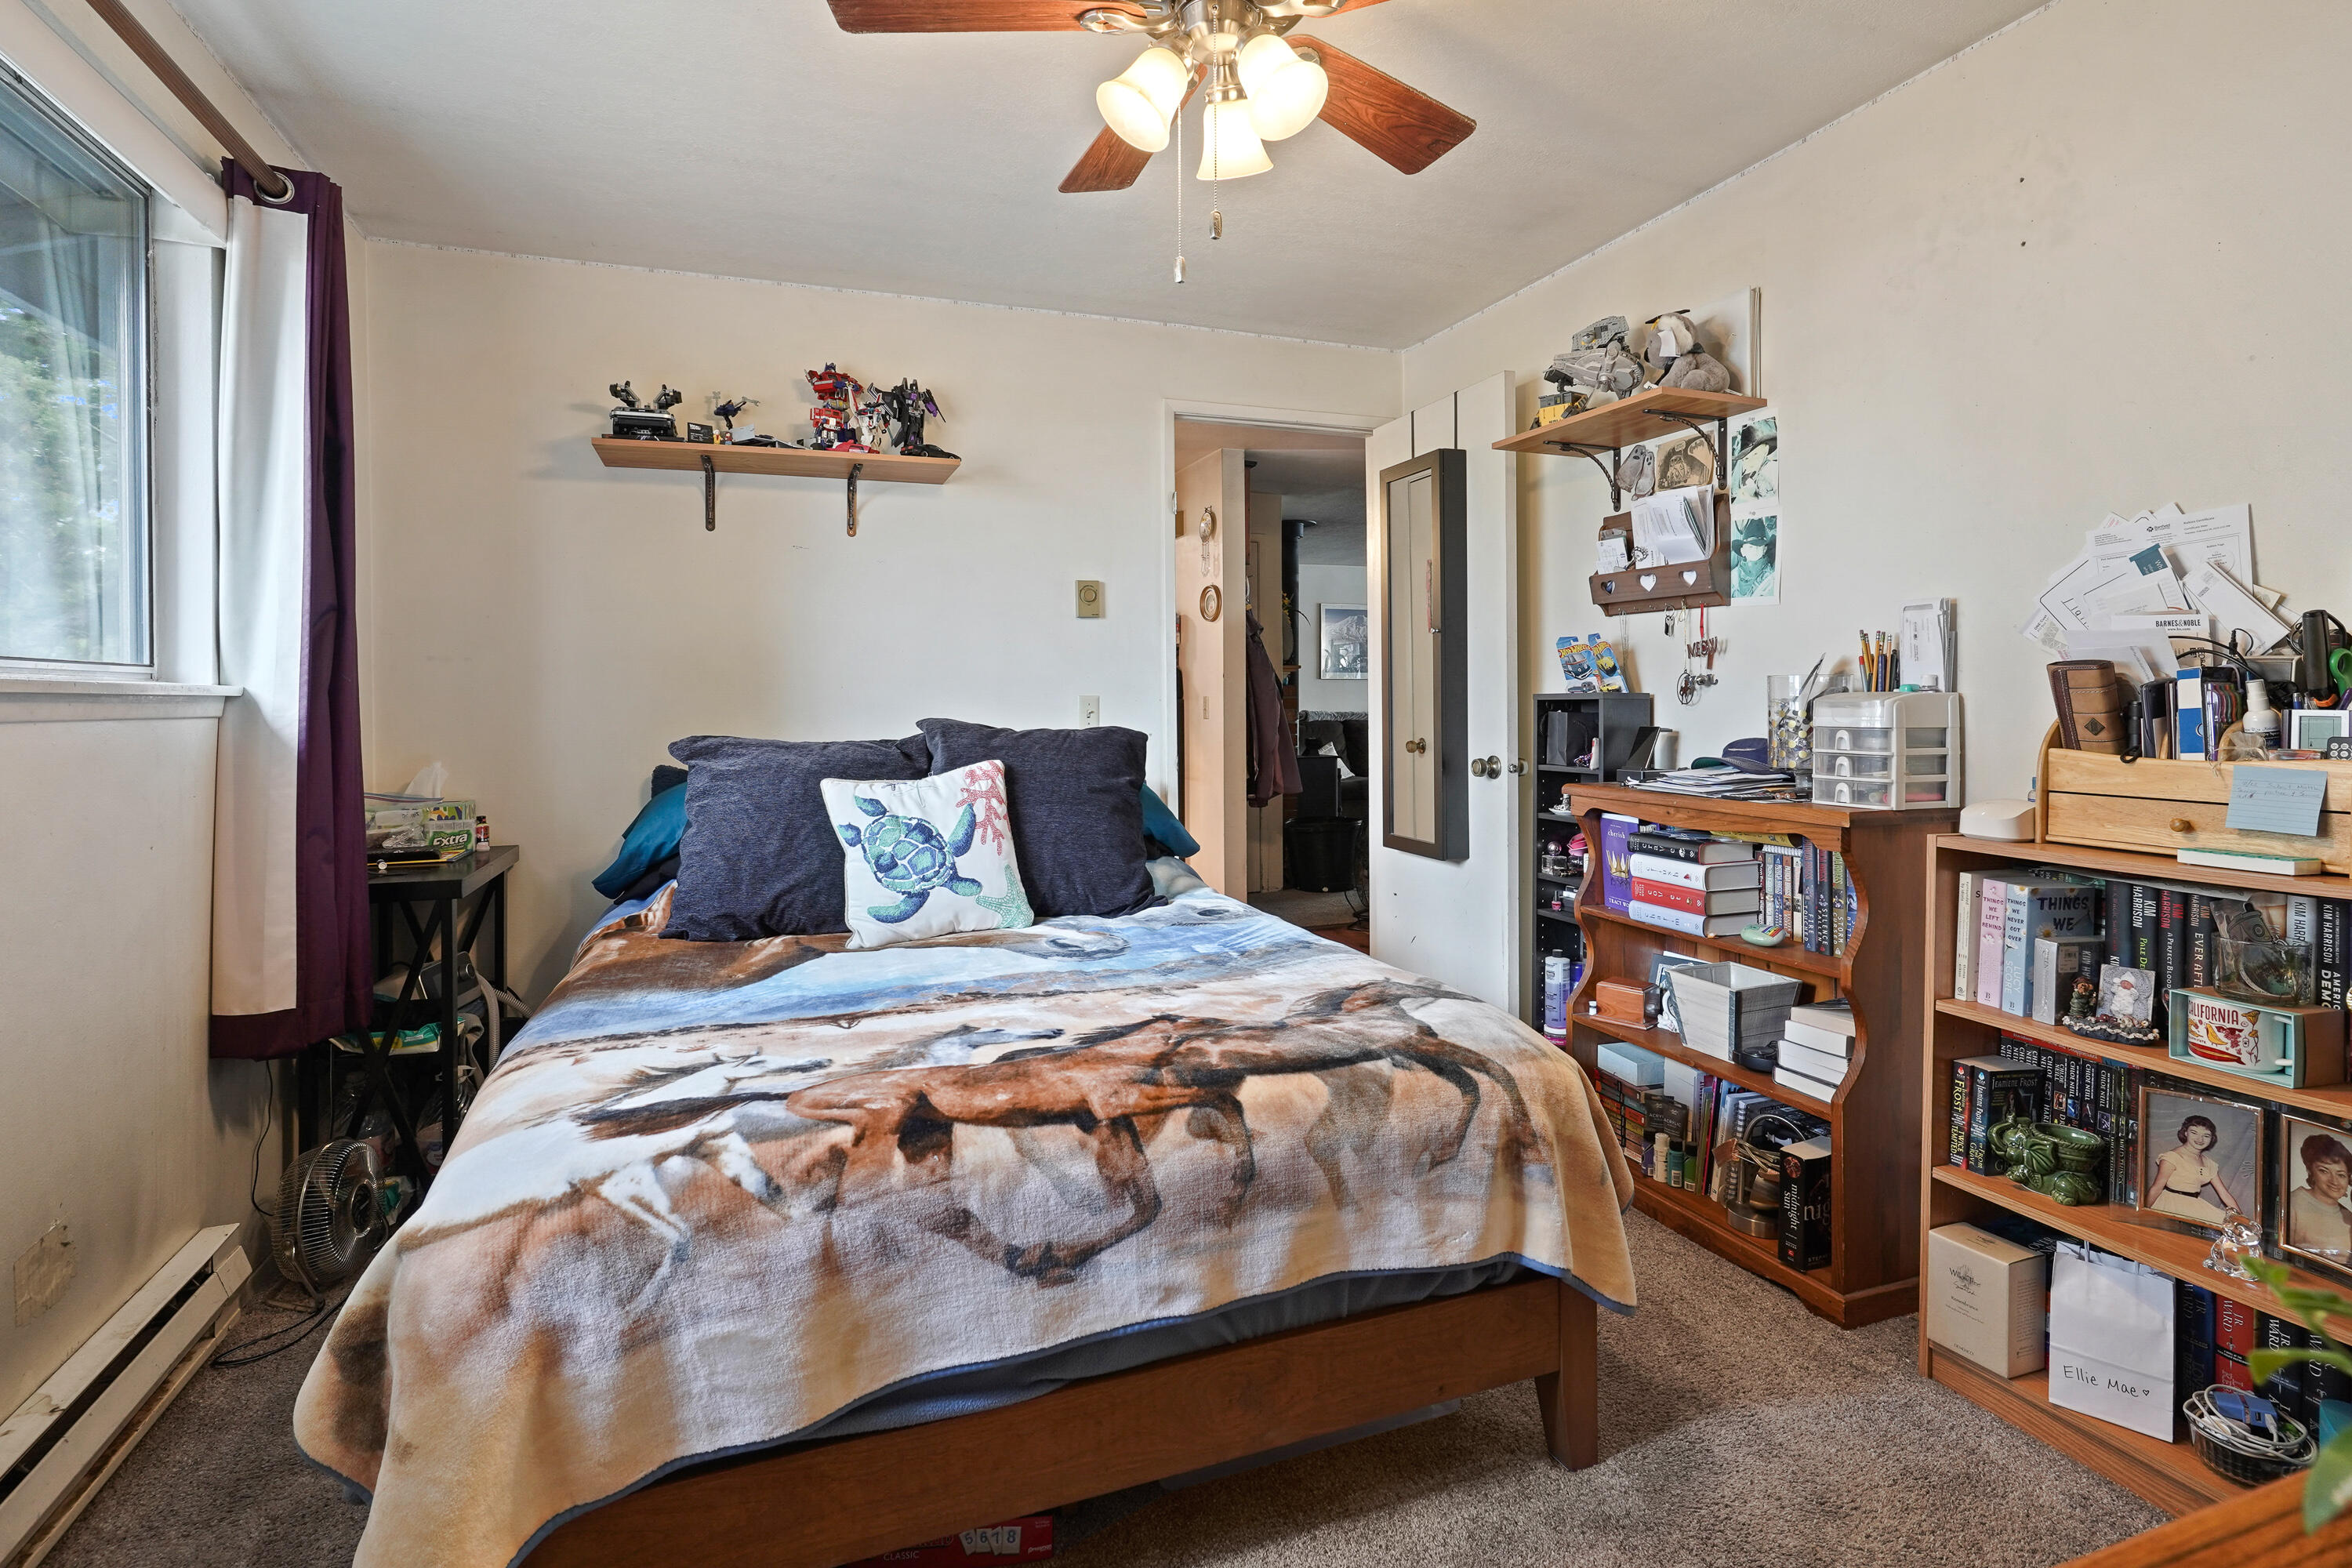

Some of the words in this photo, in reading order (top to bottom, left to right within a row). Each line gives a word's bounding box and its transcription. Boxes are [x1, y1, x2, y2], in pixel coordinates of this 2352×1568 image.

[2155, 619, 2201, 627] BARNES&NOBLE
[433, 833, 468, 846] Extra
[1607, 829, 1625, 839] cherish
[1983, 896, 2004, 906] THINGS
[2007, 898, 2027, 907] THINGS
[2036, 896, 2089, 911] THINGS
[2132, 885, 2143, 928] HARRISON
[2143, 899, 2156, 917] KIM
[2294, 902, 2307, 916] KIM
[2160, 890, 2171, 929] HARRISON
[2172, 903, 2183, 919] KIM
[2190, 895, 2200, 927] HARRISON
[2201, 906, 2210, 919] KIM
[2323, 904, 2333, 920] KIM
[1982, 922, 2002, 931] BEHIND
[2053, 916, 2075, 931] WE
[2140, 938, 2148, 956] PALE
[2194, 932, 2204, 960] EVER
[2323, 922, 2333, 964] HARRISON
[2110, 955, 2120, 966] KI
[2140, 956, 2148, 971] DE
[2004, 960, 2013, 993] SCORE
[2013, 966, 2023, 993] LUCY
[2165, 965, 2174, 989] BLOOD
[2194, 963, 2204, 988] AFT
[2020, 1077, 2038, 1087] FROST
[1953, 1079, 1965, 1112] FROST
[1976, 1083, 1986, 1107] JEANIENE
[1664, 1118, 1682, 1127] ACRYLIC
[1975, 1107, 1984, 1123] FROST
[1950, 1125, 1958, 1154] TEMPTED
[1788, 1184, 1800, 1231] midnight
[2223, 1299, 2234, 1333] WARD
[2234, 1312, 2244, 1327] JR
[2269, 1319, 2280, 1352] WARD
[2278, 1331, 2291, 1347] JR
[2309, 1334, 2322, 1377] WAD
[2063, 1365, 2099, 1386] Ellie
[2107, 1378, 2139, 1398] Mae
[964, 1532, 974, 1545] 5
[979, 1531, 988, 1544] 6
[991, 1531, 1000, 1544] 7
[1007, 1530, 1016, 1544] 8
[884, 1550, 920, 1561] CLASSIC
